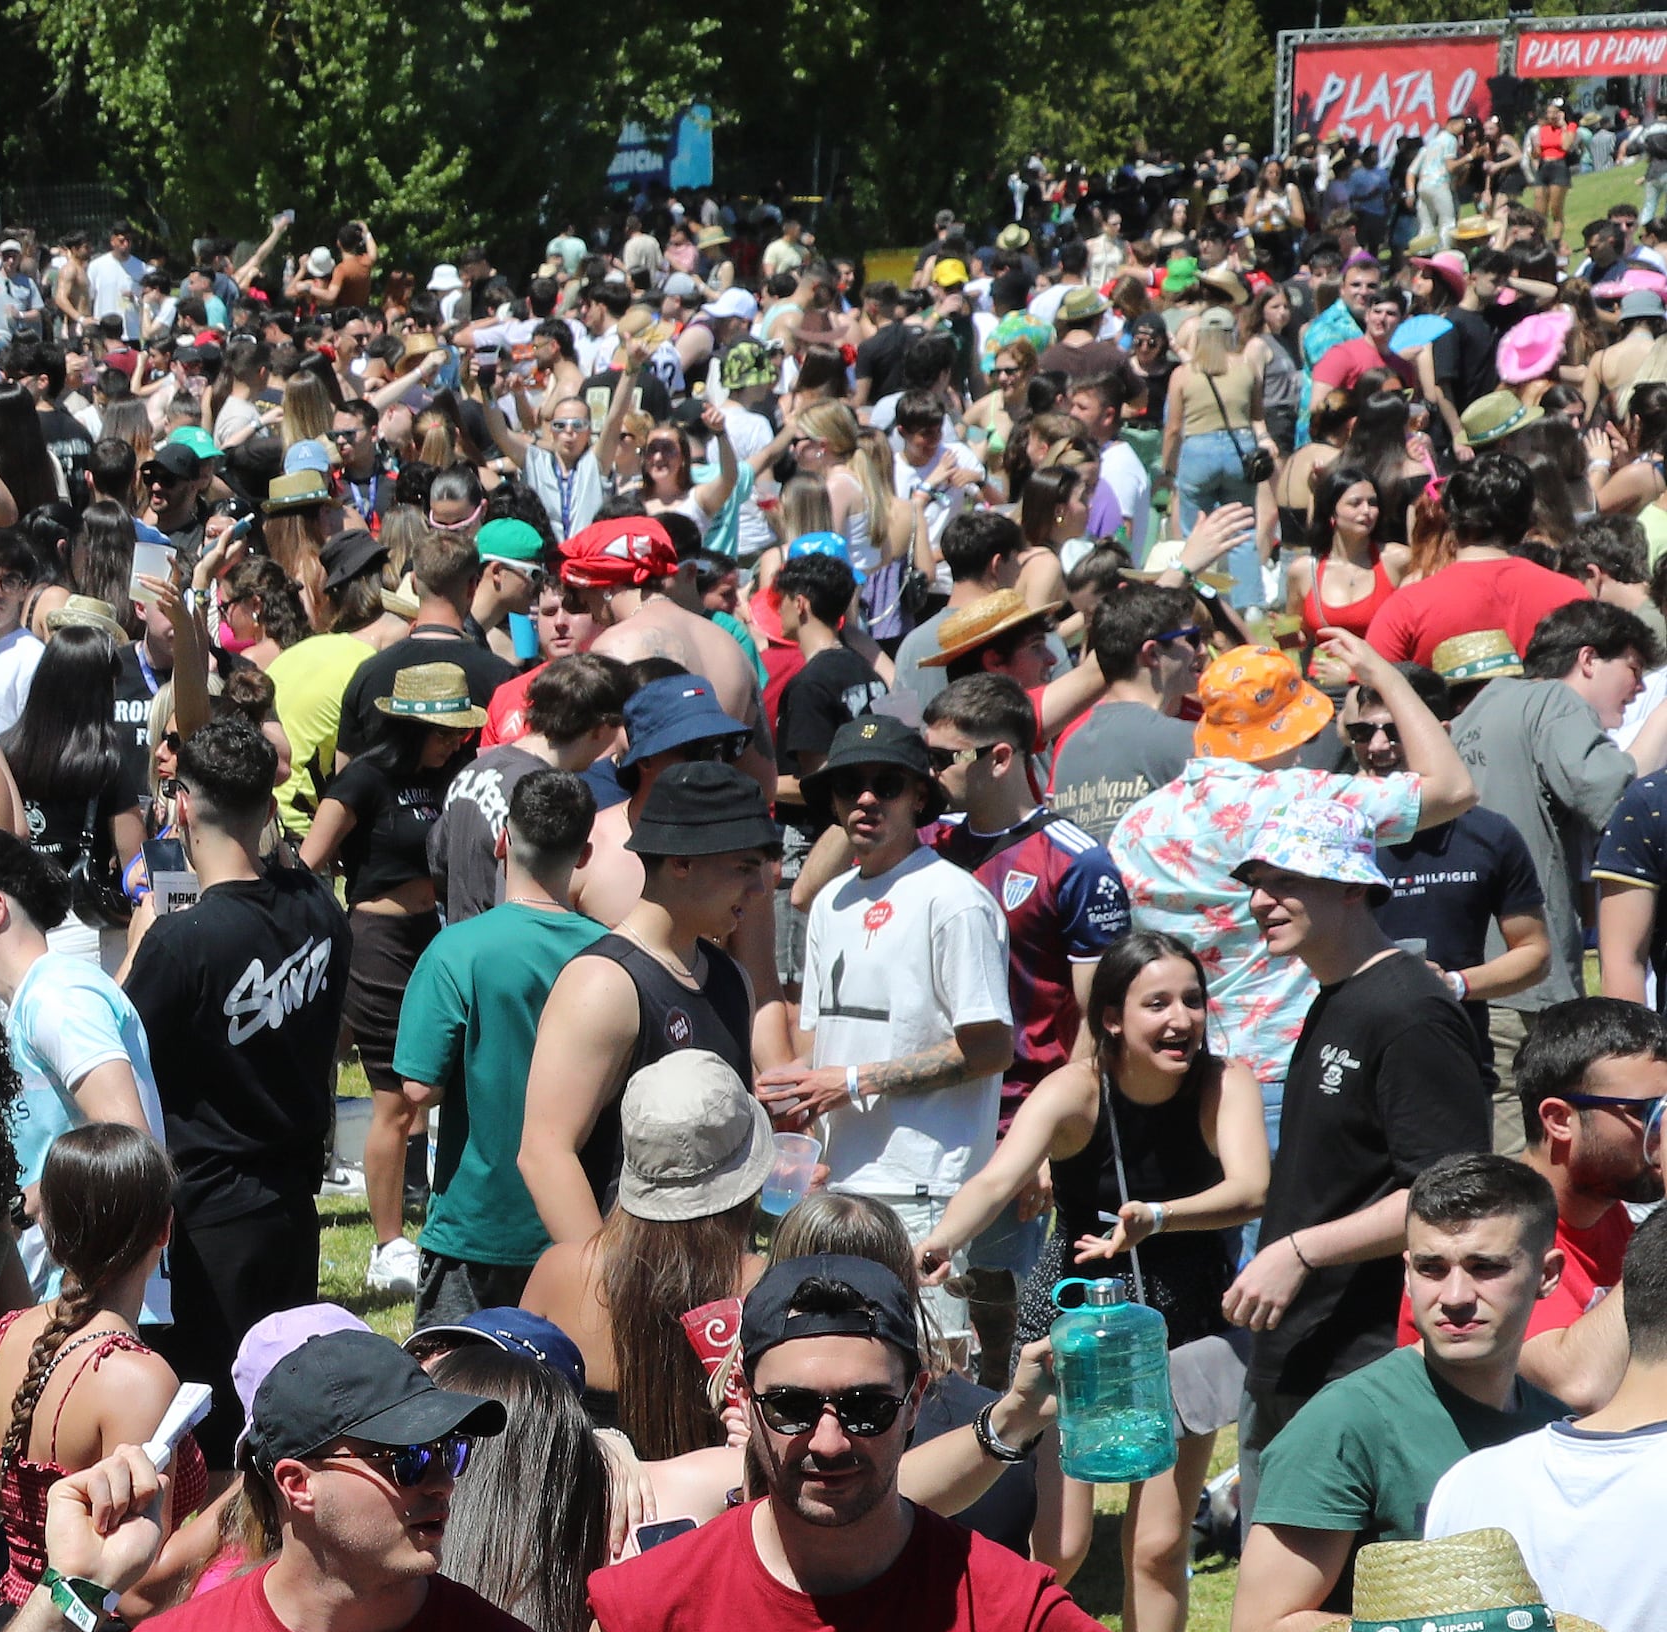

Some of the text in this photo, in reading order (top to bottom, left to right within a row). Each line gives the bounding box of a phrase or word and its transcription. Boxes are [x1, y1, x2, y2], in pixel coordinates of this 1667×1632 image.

[1523, 34, 1667, 68] PLATA O PLOMO
[1313, 68, 1478, 122] PLATA O
[1415, 871, 1478, 884] HILFIGER
